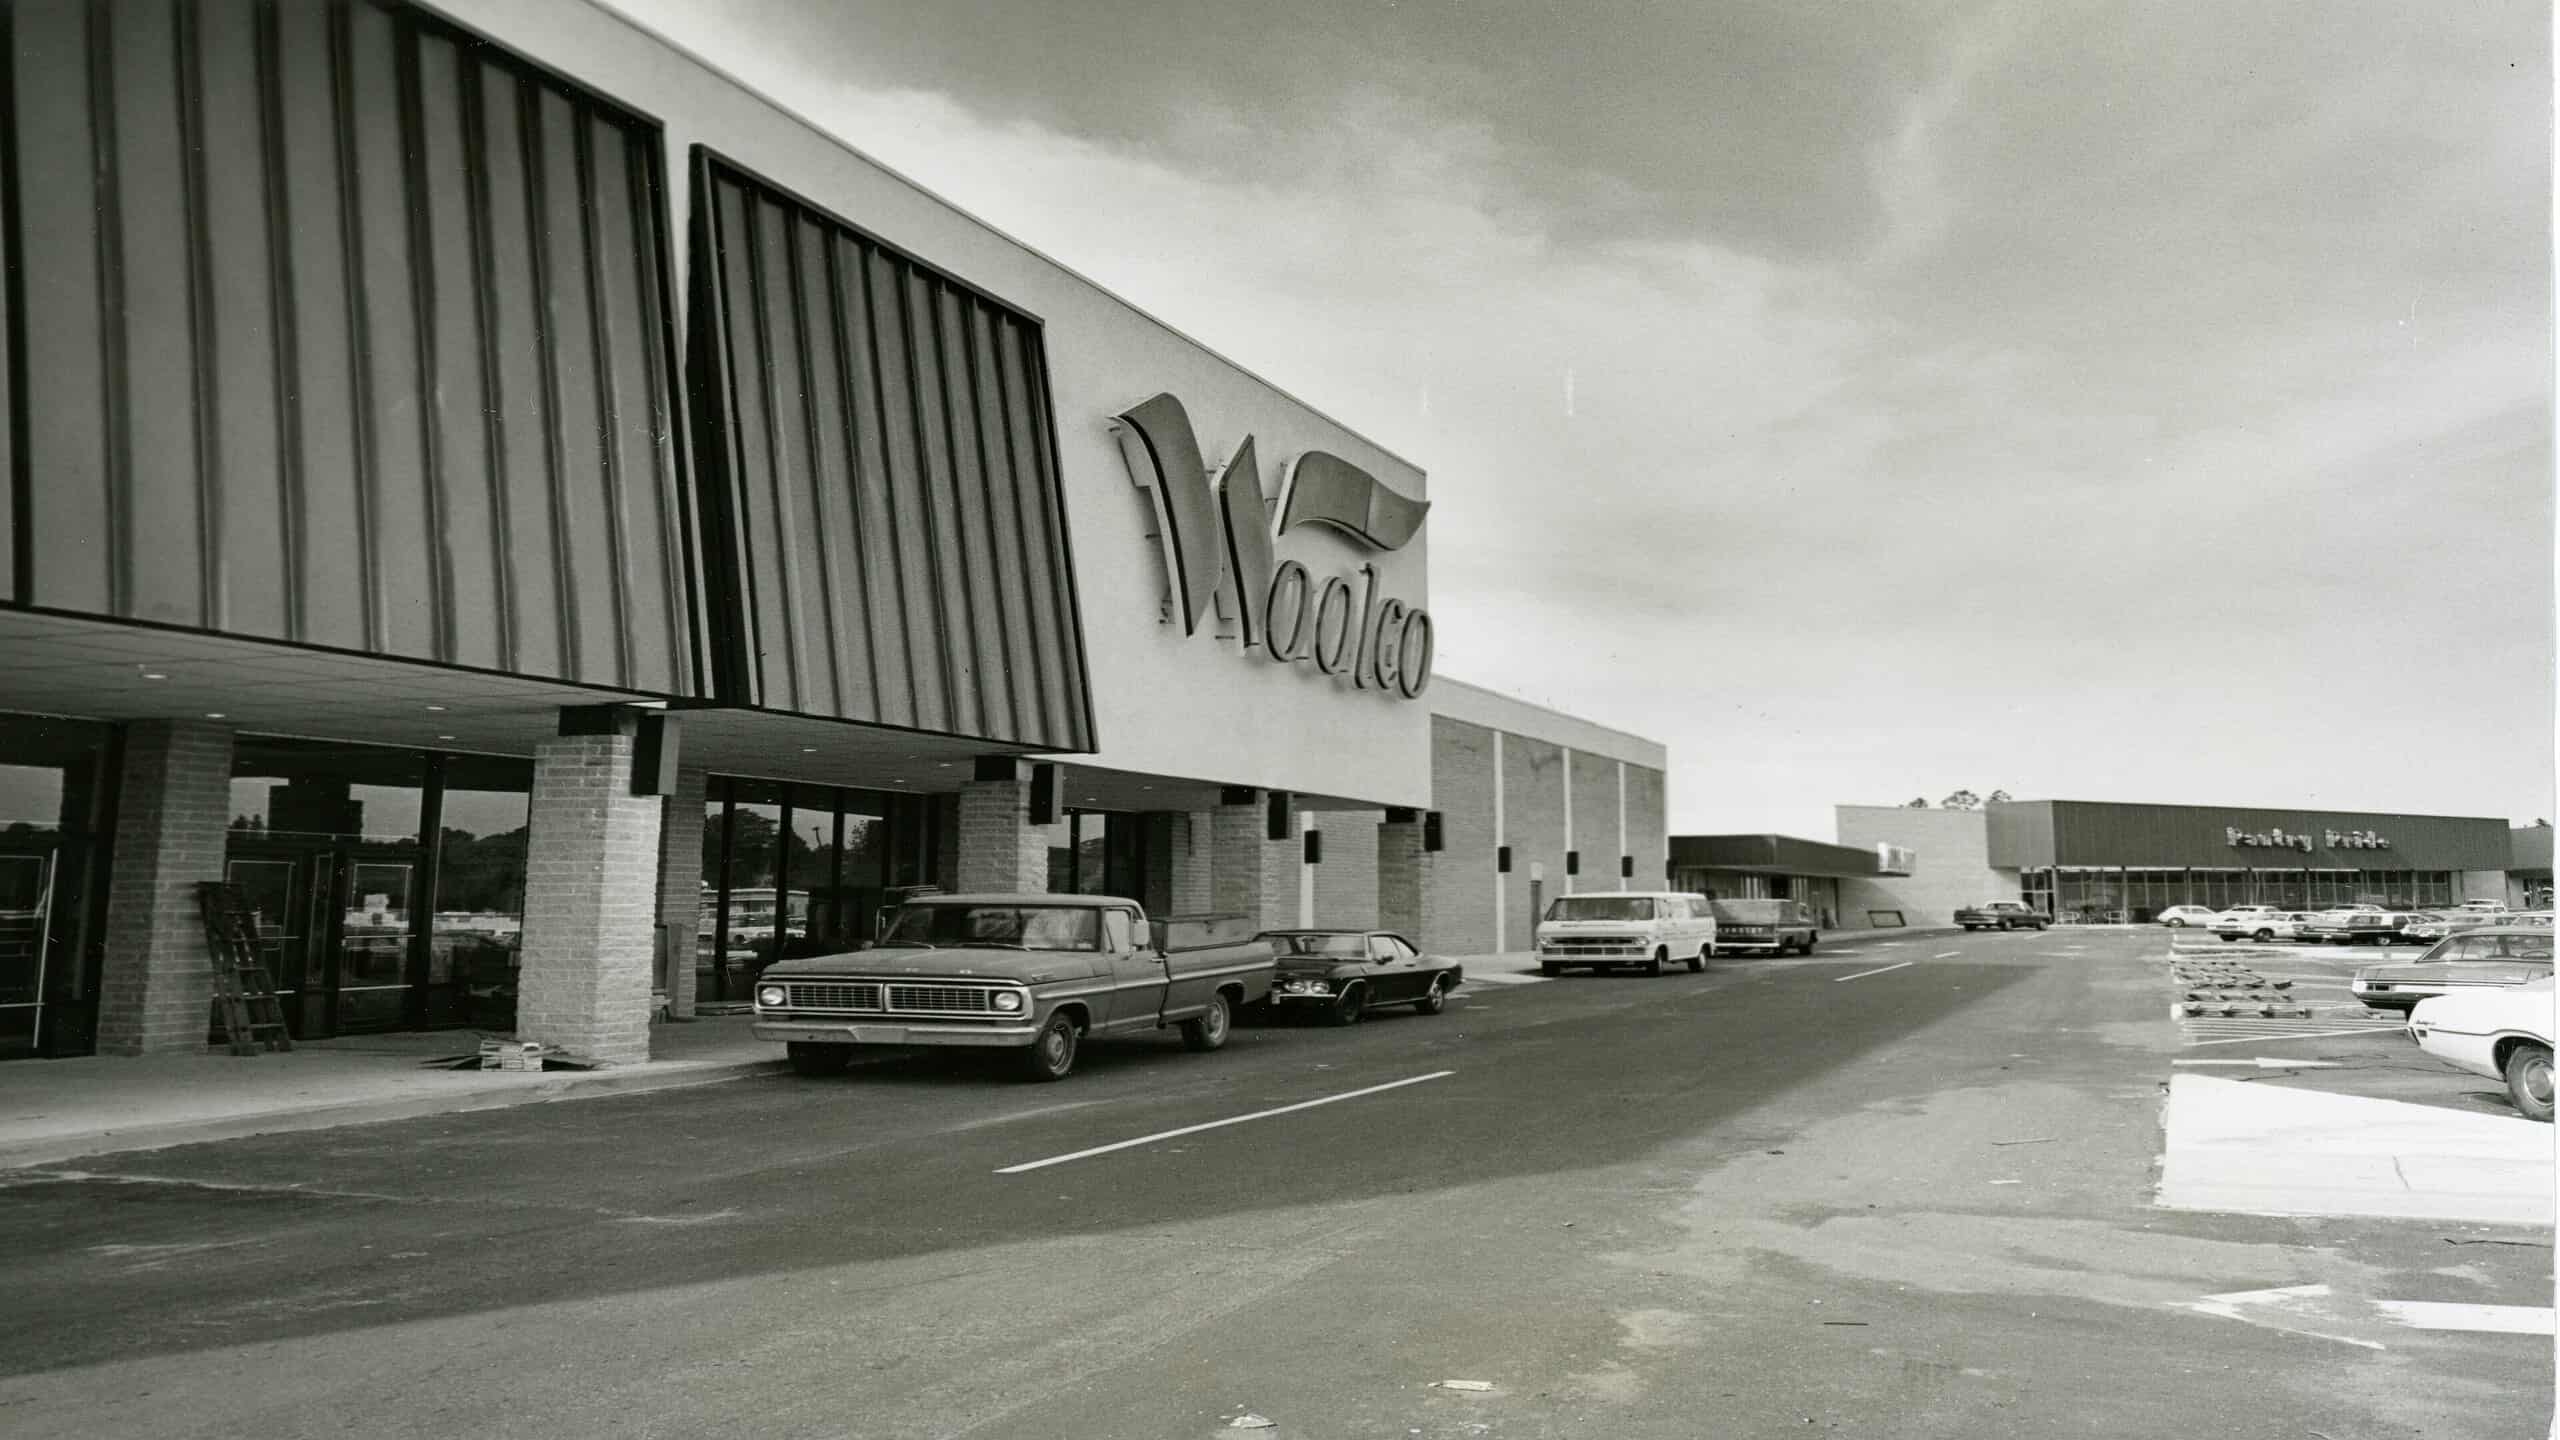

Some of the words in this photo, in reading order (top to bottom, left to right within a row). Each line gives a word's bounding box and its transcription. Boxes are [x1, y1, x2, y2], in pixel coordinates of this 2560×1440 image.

[1108, 392, 1433, 699] Woolco
[2226, 826, 2312, 852] Pantry
[2325, 828, 2392, 849] Pride
